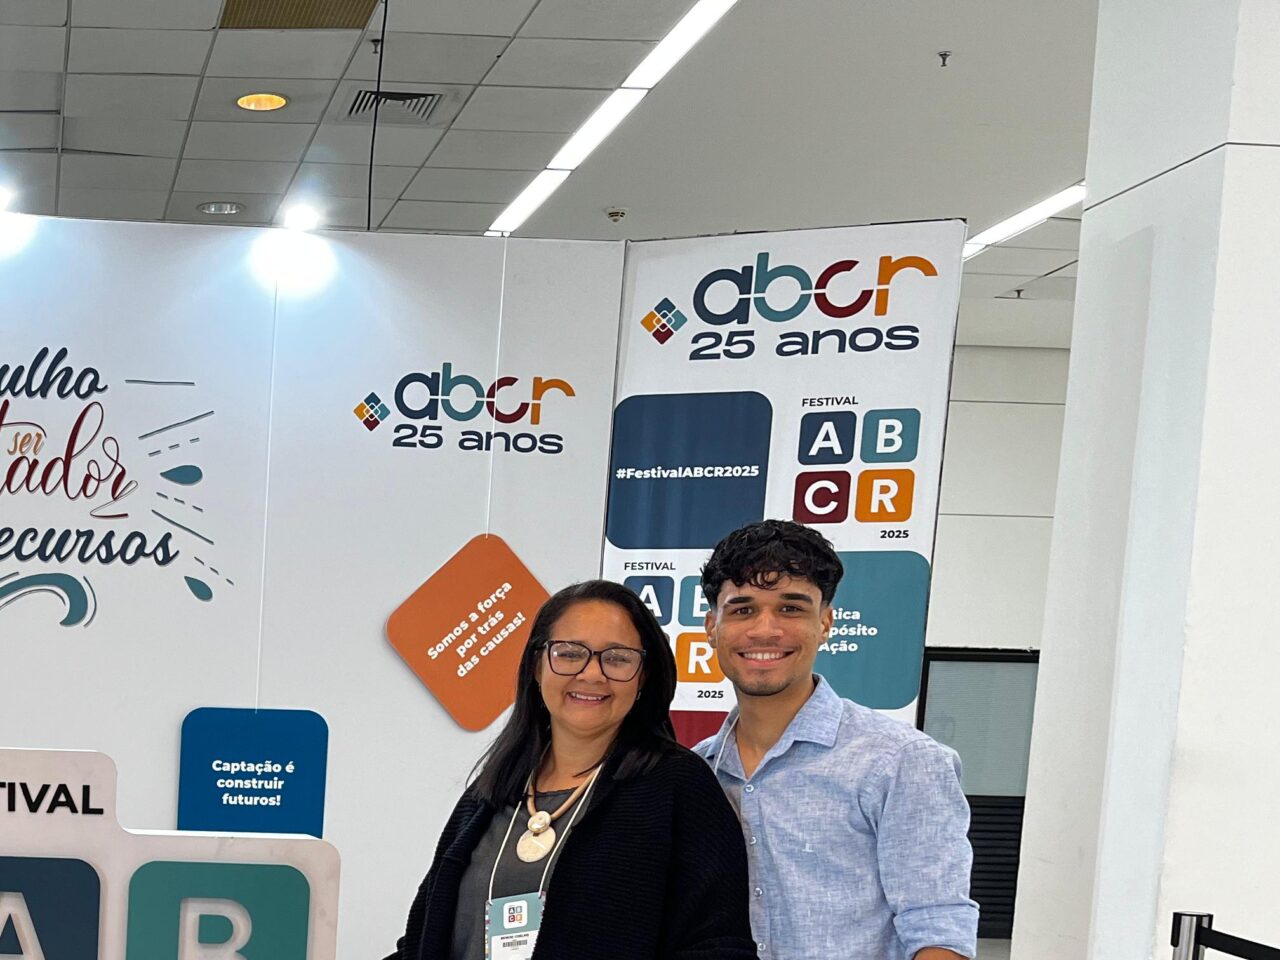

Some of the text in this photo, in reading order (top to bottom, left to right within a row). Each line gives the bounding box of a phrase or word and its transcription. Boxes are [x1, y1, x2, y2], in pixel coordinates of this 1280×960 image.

[693, 252, 938, 326] abcr
[689, 325, 919, 361] 25 anos
[394, 362, 576, 425] abcr
[801, 396, 859, 408] FESTIVAL
[7, 431, 45, 456] ser
[392, 424, 563, 454] 25 anos
[808, 418, 903, 456] A B
[615, 466, 760, 480] #FestivalABCR2025
[803, 478, 899, 515] C R
[880, 530, 910, 539] 2025
[624, 562, 676, 571] FESTIVAL
[639, 584, 663, 618] A
[832, 607, 861, 620] tica
[427, 582, 512, 660] Somos a força
[828, 623, 878, 638] pósito
[456, 610, 504, 658] por trás
[457, 611, 526, 677] das causas!
[687, 641, 714, 674] R
[817, 640, 859, 655] Ação
[697, 690, 724, 699] 2025
[212, 760, 295, 776] Captação é
[217, 777, 285, 790] construir
[222, 793, 281, 806] futuros!
